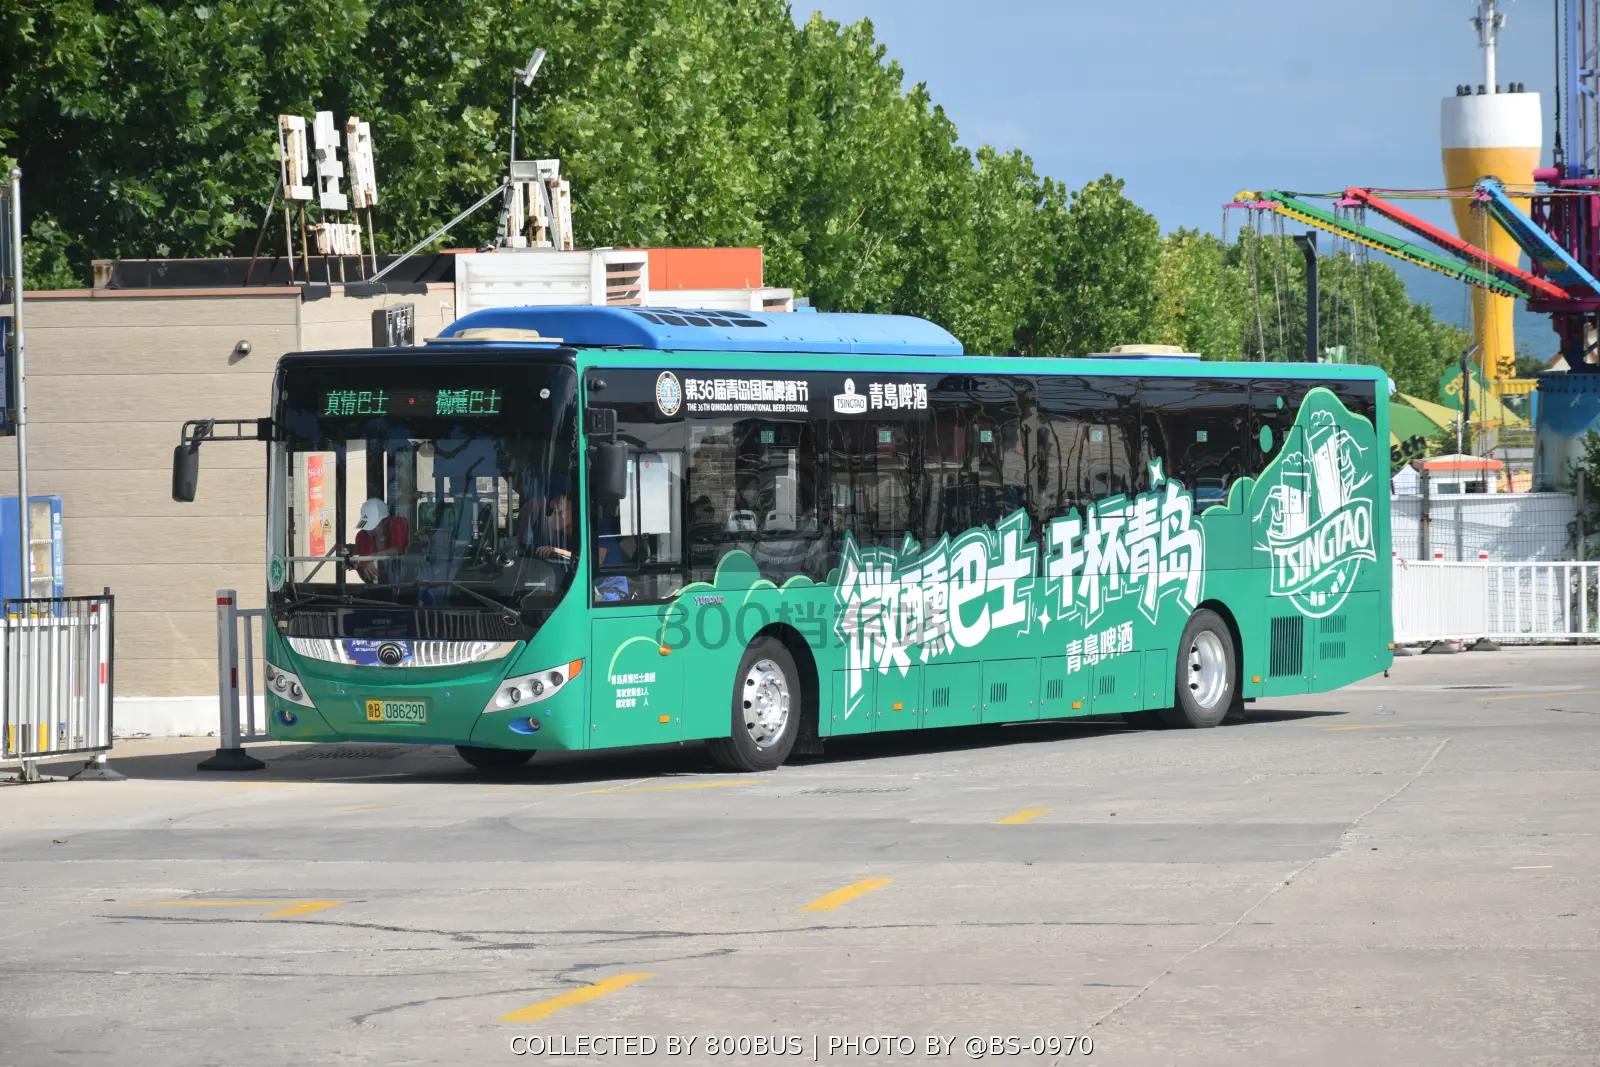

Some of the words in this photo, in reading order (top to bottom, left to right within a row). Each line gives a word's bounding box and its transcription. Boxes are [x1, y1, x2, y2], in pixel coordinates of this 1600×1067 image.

[324, 389, 390, 416] 真情巴士
[685, 378, 809, 402] 第36届青岛国际啤酒节
[836, 398, 865, 409] TSINGTAO
[868, 382, 928, 410] 青島啤酒
[686, 402, 697, 412] THE
[697, 403, 711, 412] 36TH
[711, 403, 733, 412] QINGDAO
[733, 403, 773, 412] INTERNATIONAL
[773, 404, 786, 412] BEER
[786, 404, 809, 413] FESTIVAL
[1049, 482, 1203, 615] 干杯青岛
[1274, 506, 1370, 588] TSINGTAO
[1065, 620, 1134, 675] 青島啤酒
